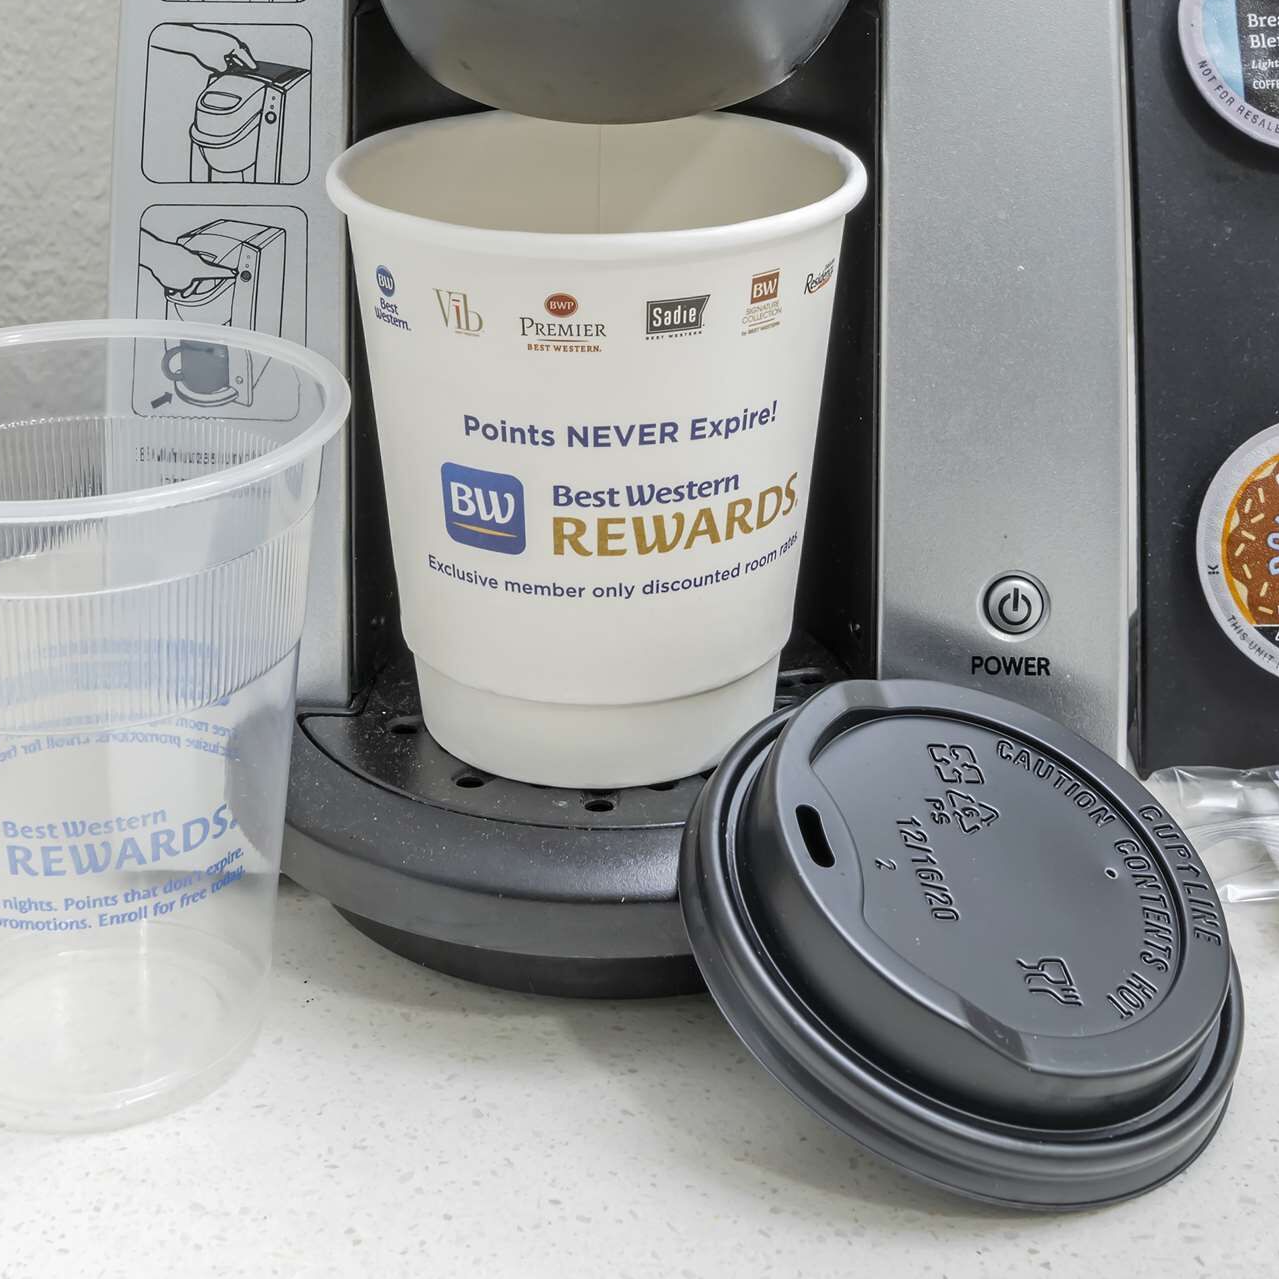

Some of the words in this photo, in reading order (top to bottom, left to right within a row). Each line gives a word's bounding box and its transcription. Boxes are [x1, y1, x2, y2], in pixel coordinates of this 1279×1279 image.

[1197, 60, 1216, 85] NOT
[1217, 86, 1235, 106] FOR
[1251, 58, 1279, 71] Light
[380, 297, 399, 315] Best
[549, 300, 575, 310] BWP
[752, 278, 778, 300] BW
[520, 316, 608, 337] PREMIER
[652, 305, 697, 328] Sadie
[527, 343, 551, 352] BEST
[464, 414, 555, 447] Points
[567, 422, 679, 447] NEVER
[690, 400, 777, 440] Expire!
[450, 481, 515, 525] BW
[552, 485, 620, 508] Best
[625, 473, 740, 507] Western
[428, 553, 498, 589] Exclusive
[504, 578, 586, 598] member
[592, 582, 635, 599] only
[642, 564, 741, 596] discounted
[744, 549, 777, 574] room
[1227, 615, 1248, 640] THIS
[1248, 640, 1274, 663] UNIT
[971, 656, 1051, 677] POWER
[996, 739, 1117, 828] CAUTION
[2, 820, 60, 839] Best
[62, 808, 167, 838] Western
[2, 896, 58, 914] nights.
[64, 894, 118, 912] Points
[122, 886, 159, 904] that
[163, 870, 202, 894] don't
[206, 847, 245, 877] expire.
[896, 816, 960, 921] 12/16/20
[98, 904, 148, 927] Enroll
[153, 899, 177, 917] for
[180, 888, 208, 908] free
[1113, 837, 1173, 973] CONTENTS
[1182, 880, 1222, 947] LINE
[1105, 970, 1158, 1020] HOT
